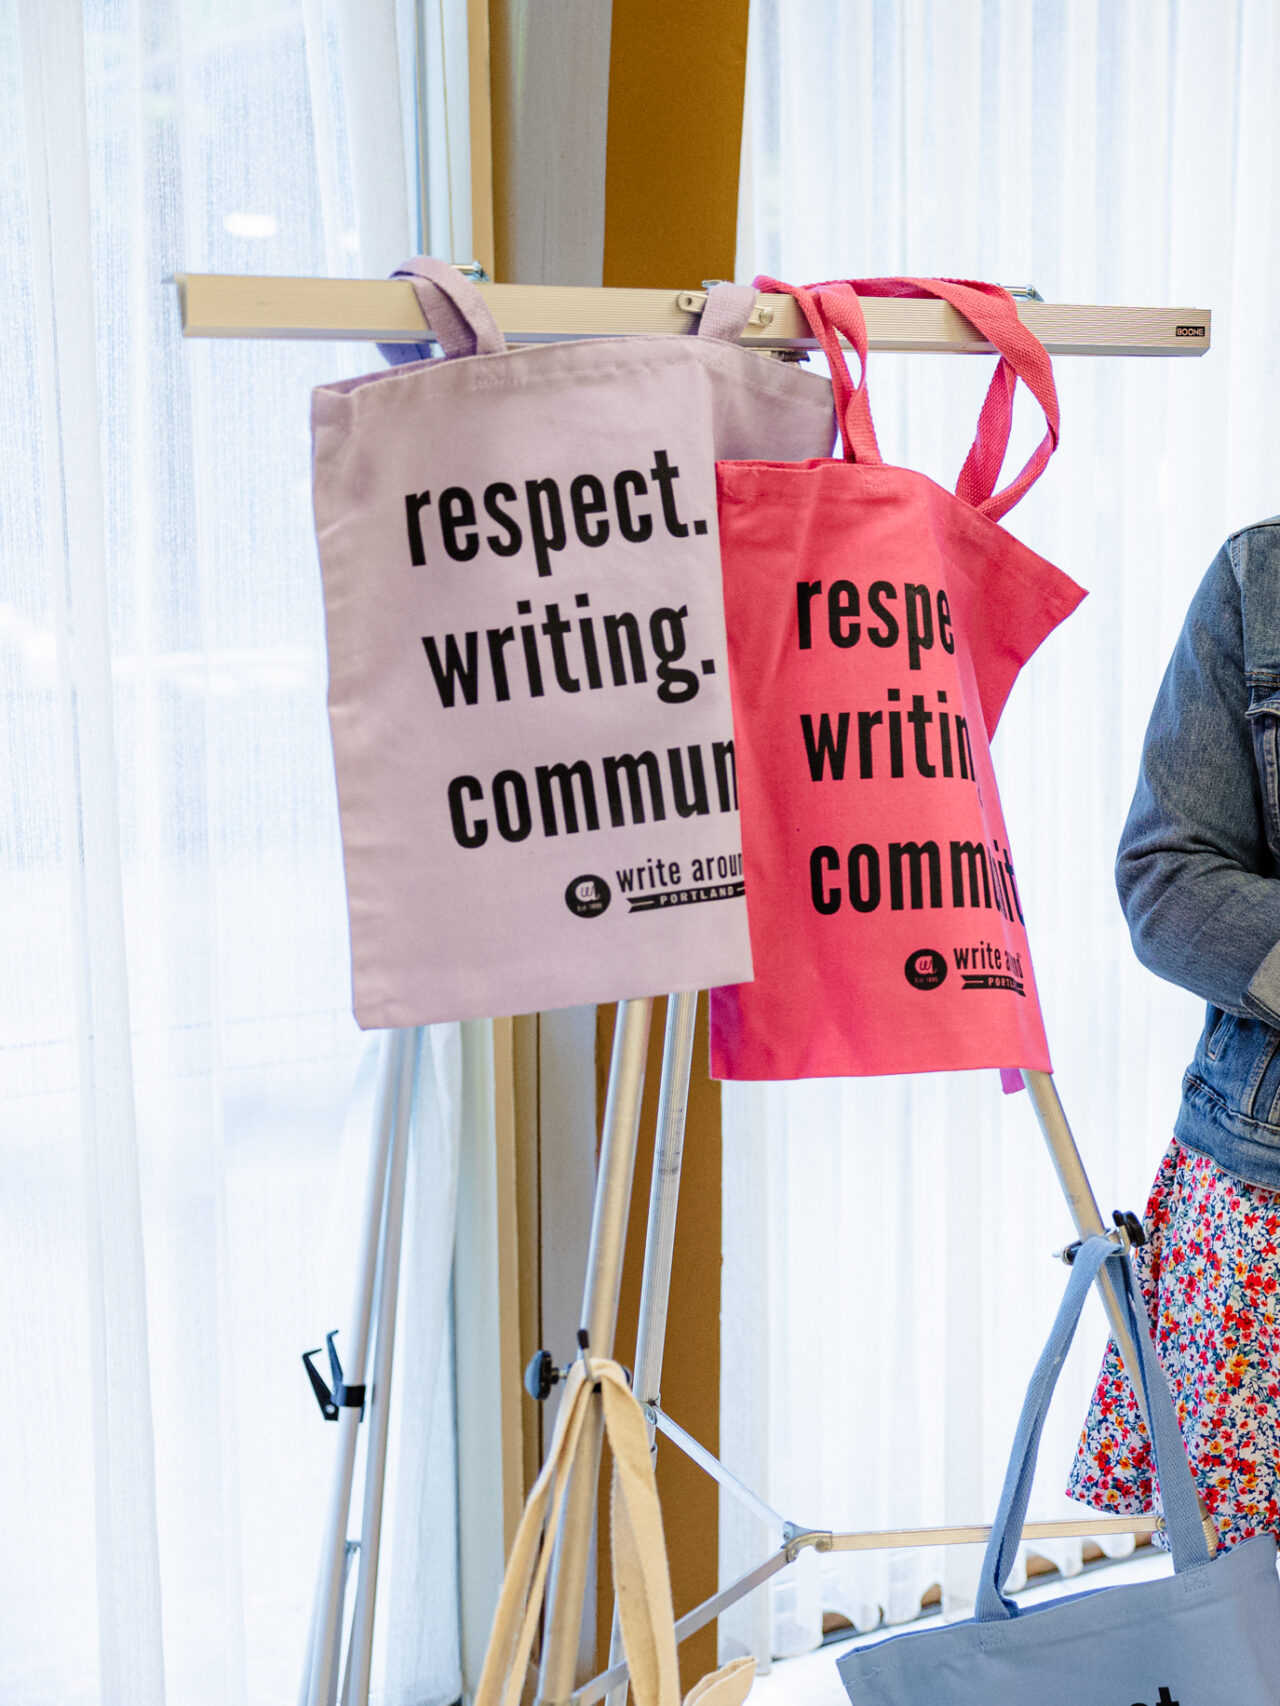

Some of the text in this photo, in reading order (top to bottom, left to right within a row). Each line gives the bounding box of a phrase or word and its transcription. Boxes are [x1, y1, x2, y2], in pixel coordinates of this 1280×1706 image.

[1176, 327, 1204, 336] BOONE
[405, 449, 708, 577] respect.
[421, 593, 716, 708] writing.
[800, 688, 980, 806] writin
[615, 858, 682, 893] write
[660, 886, 734, 905] PORTLAND
[953, 941, 1002, 970] write
